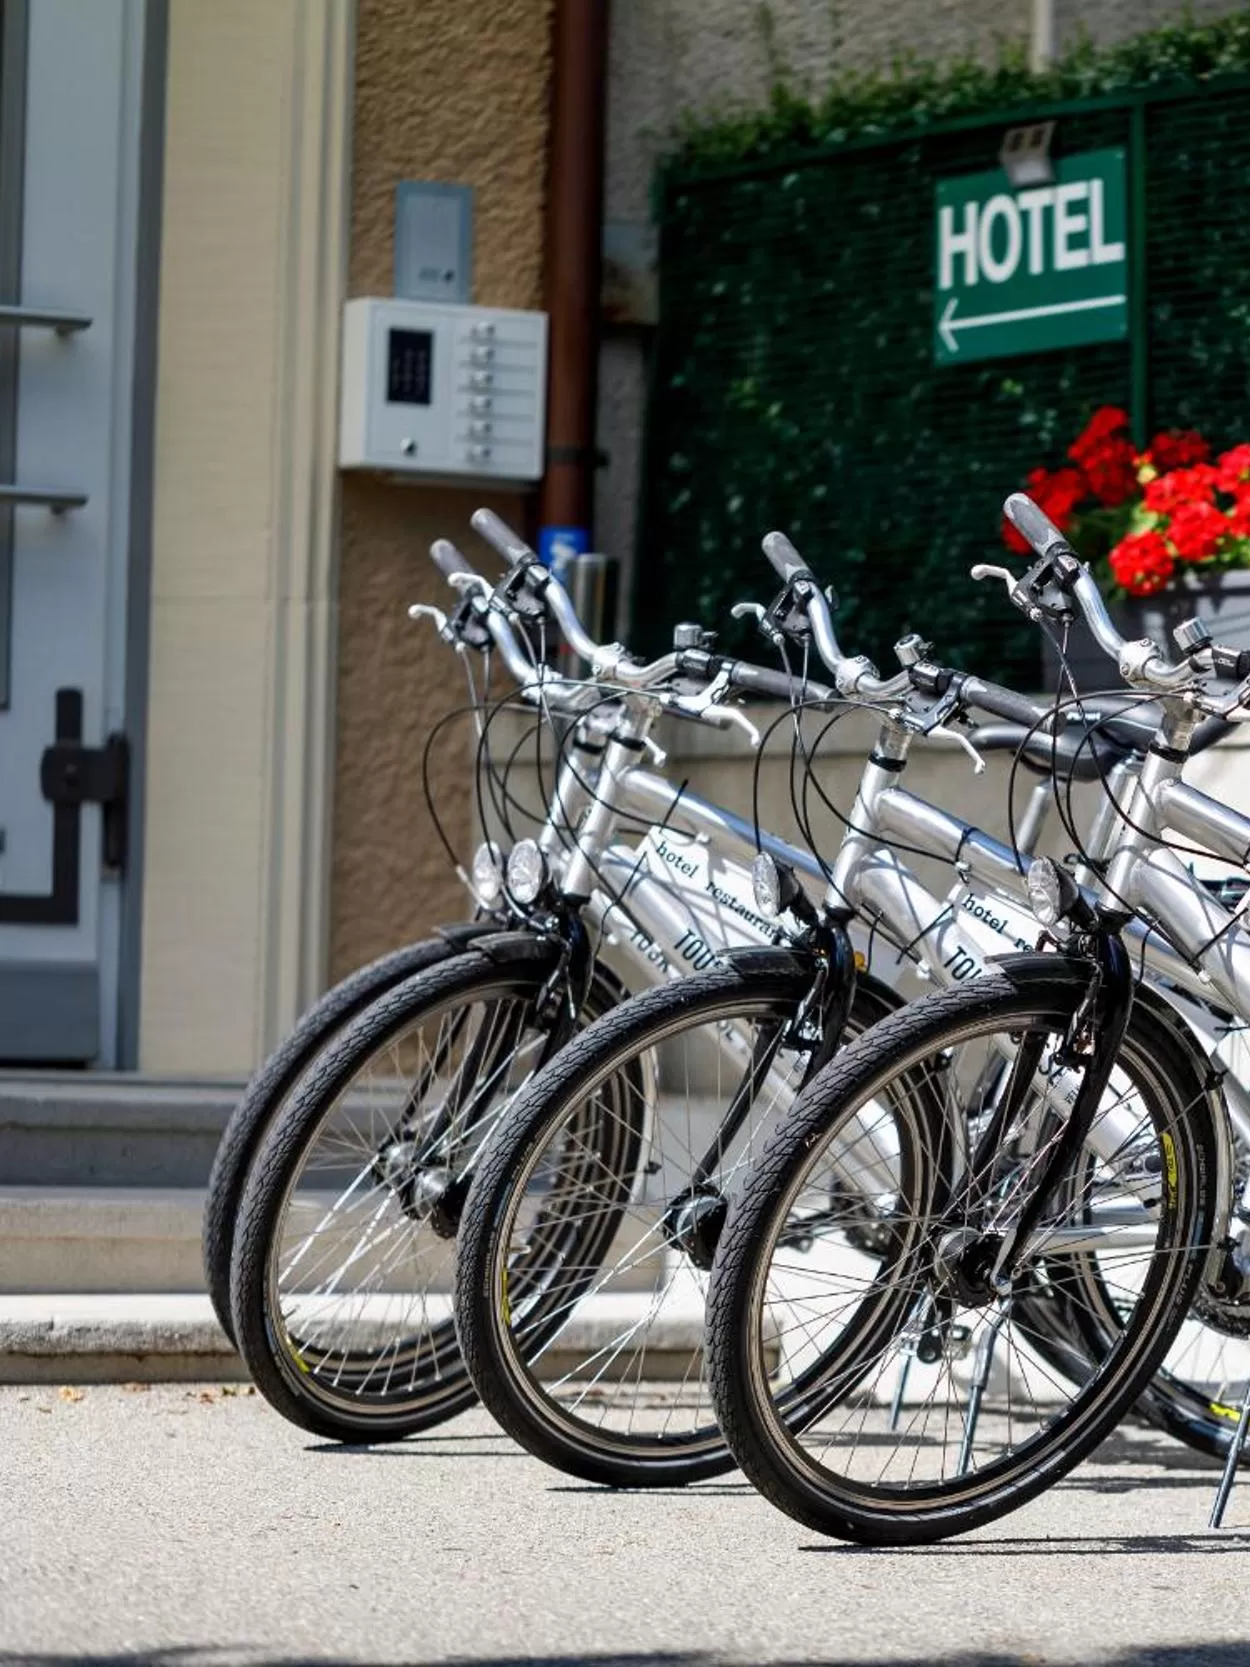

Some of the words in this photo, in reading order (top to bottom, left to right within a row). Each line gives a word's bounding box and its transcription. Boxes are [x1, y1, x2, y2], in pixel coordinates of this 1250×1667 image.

[939, 178, 1125, 290] HOTEL
[656, 841, 699, 878] hotel
[961, 893, 1008, 934] hotel
